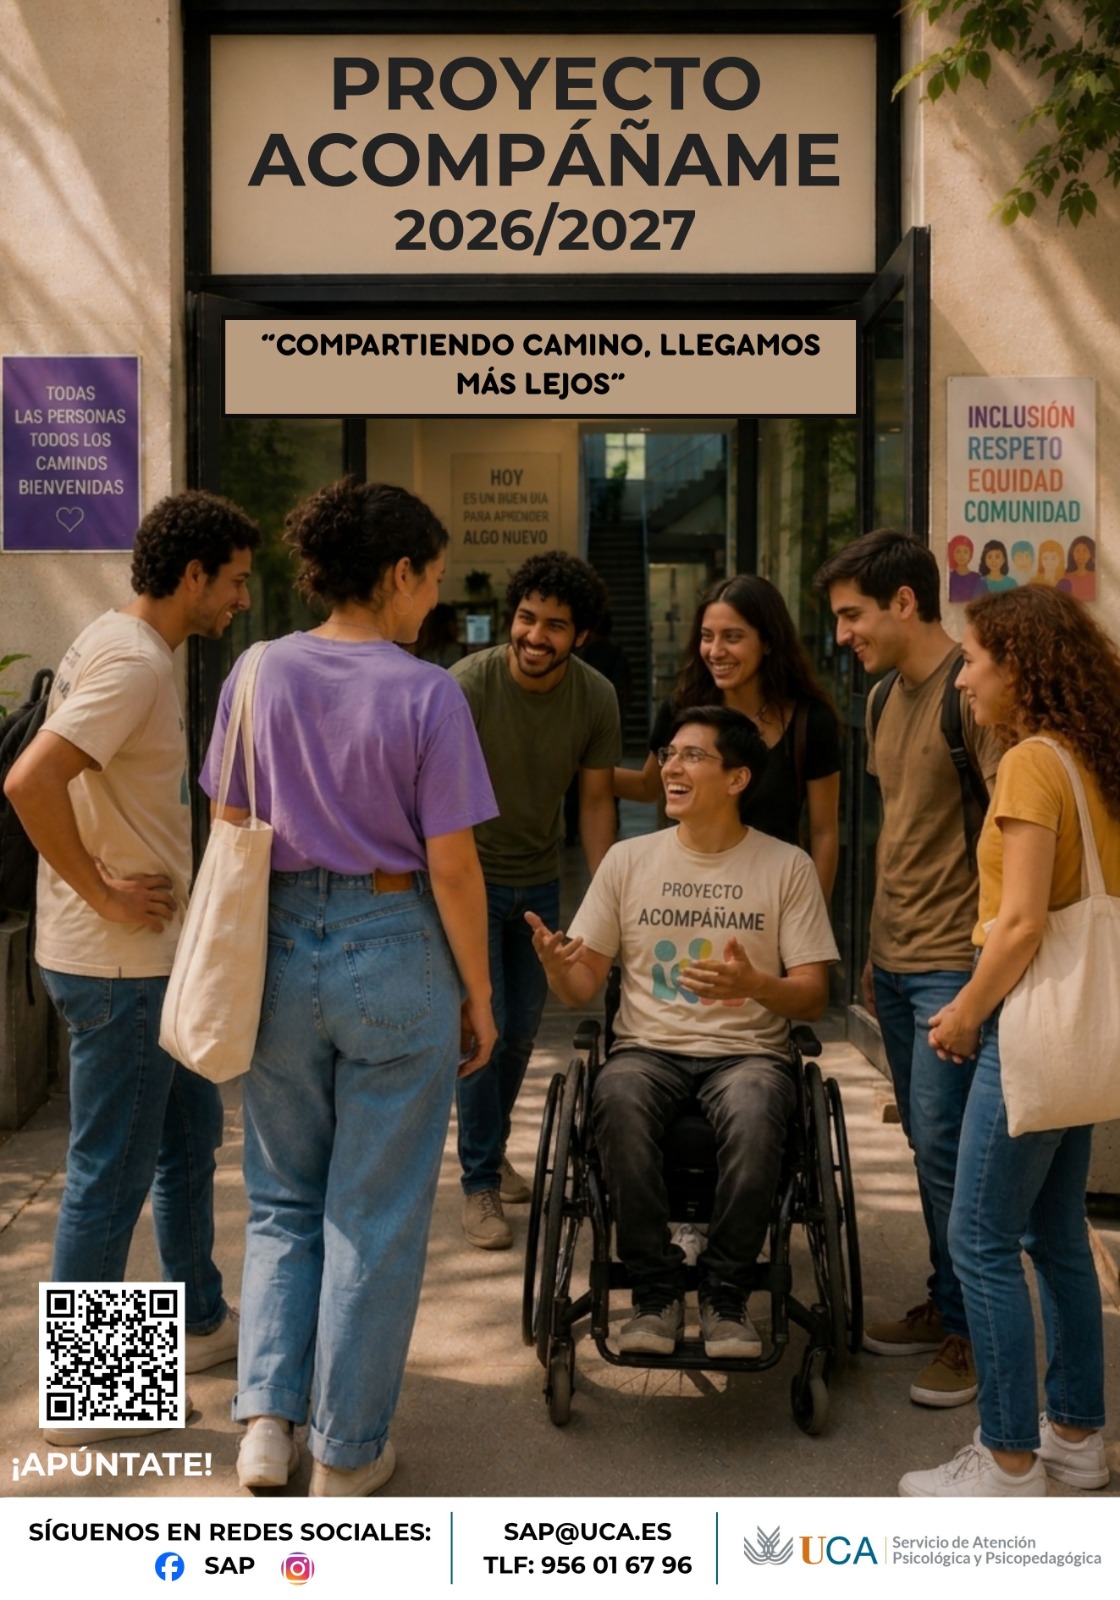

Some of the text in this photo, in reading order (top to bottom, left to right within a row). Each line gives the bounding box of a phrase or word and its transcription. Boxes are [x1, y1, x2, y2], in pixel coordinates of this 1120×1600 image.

[46, 386, 96, 401] TODAS
[15, 409, 126, 424] LAS PERSONAS
[968, 400, 1076, 428] INCLUSIÓN
[30, 432, 111, 447] TODOS LOS
[968, 436, 1062, 460] RESPETO
[490, 469, 523, 486] HOY
[968, 468, 1063, 494] EQUIDAD
[19, 479, 124, 495] BIENVENIDAS
[964, 500, 1081, 523] COMUNIDAD
[463, 529, 548, 544] ALGO NUEVO
[662, 882, 743, 899] PROYECTO
